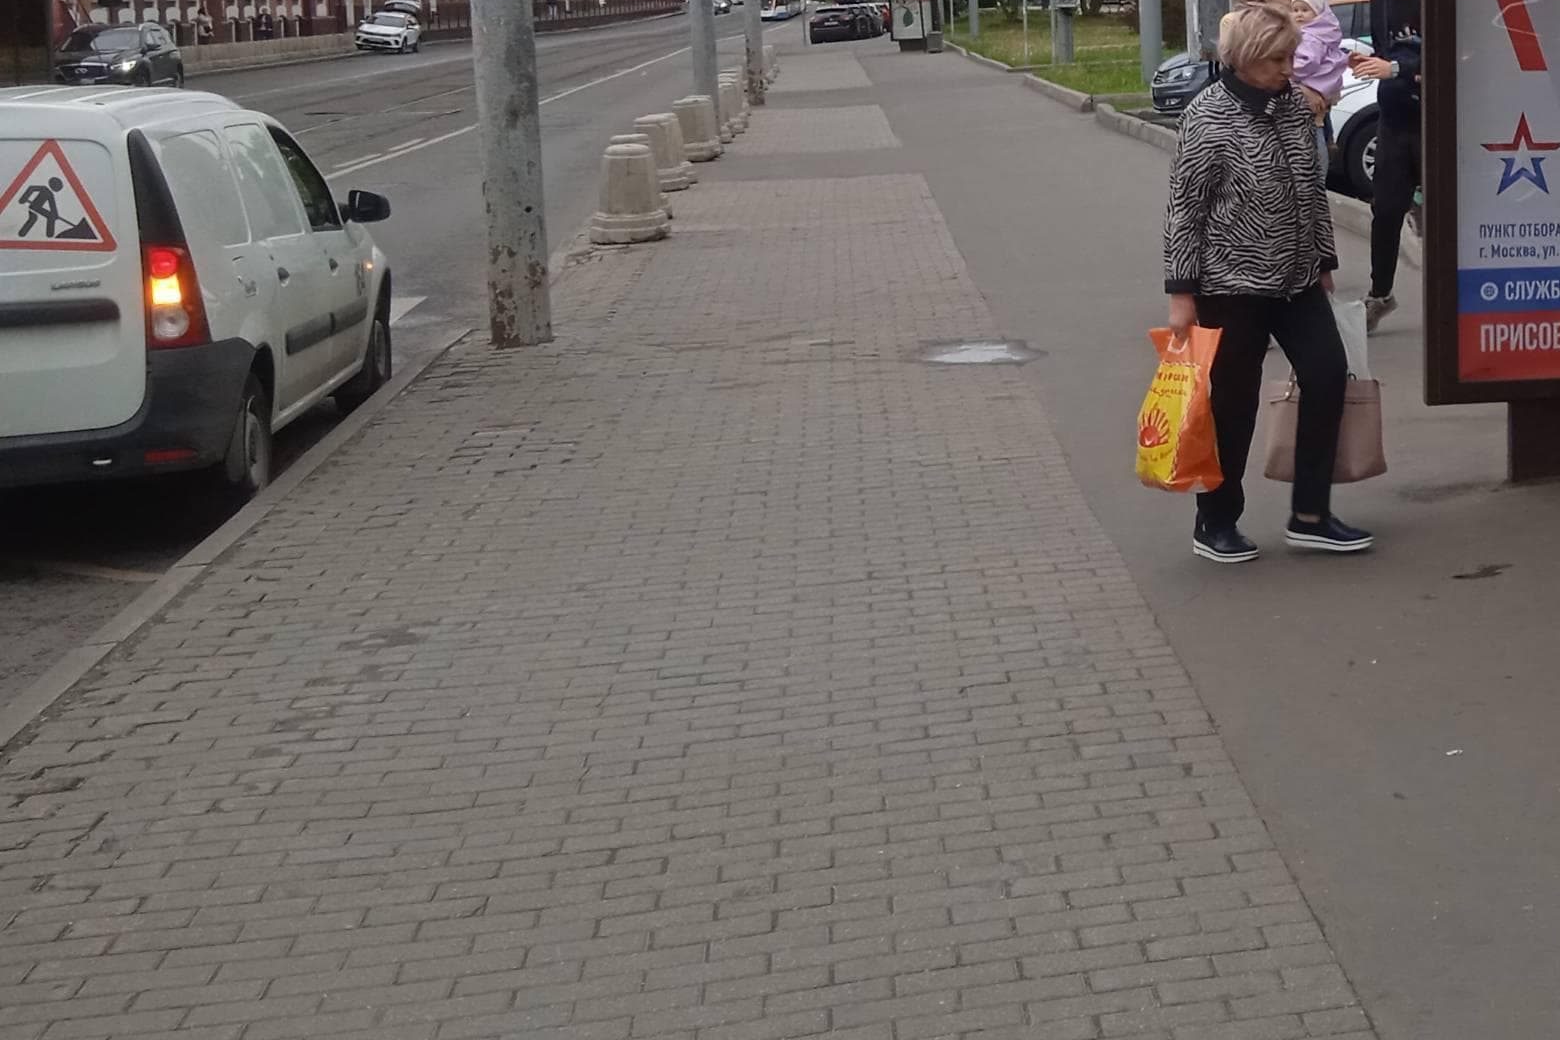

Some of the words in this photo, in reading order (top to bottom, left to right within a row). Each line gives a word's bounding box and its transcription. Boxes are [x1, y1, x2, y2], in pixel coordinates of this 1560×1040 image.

[1480, 224, 1516, 238] ПУНКТ
[1480, 247, 1488, 258] г.
[1491, 244, 1540, 259] Москва,
[1543, 245, 1559, 260] ул.
